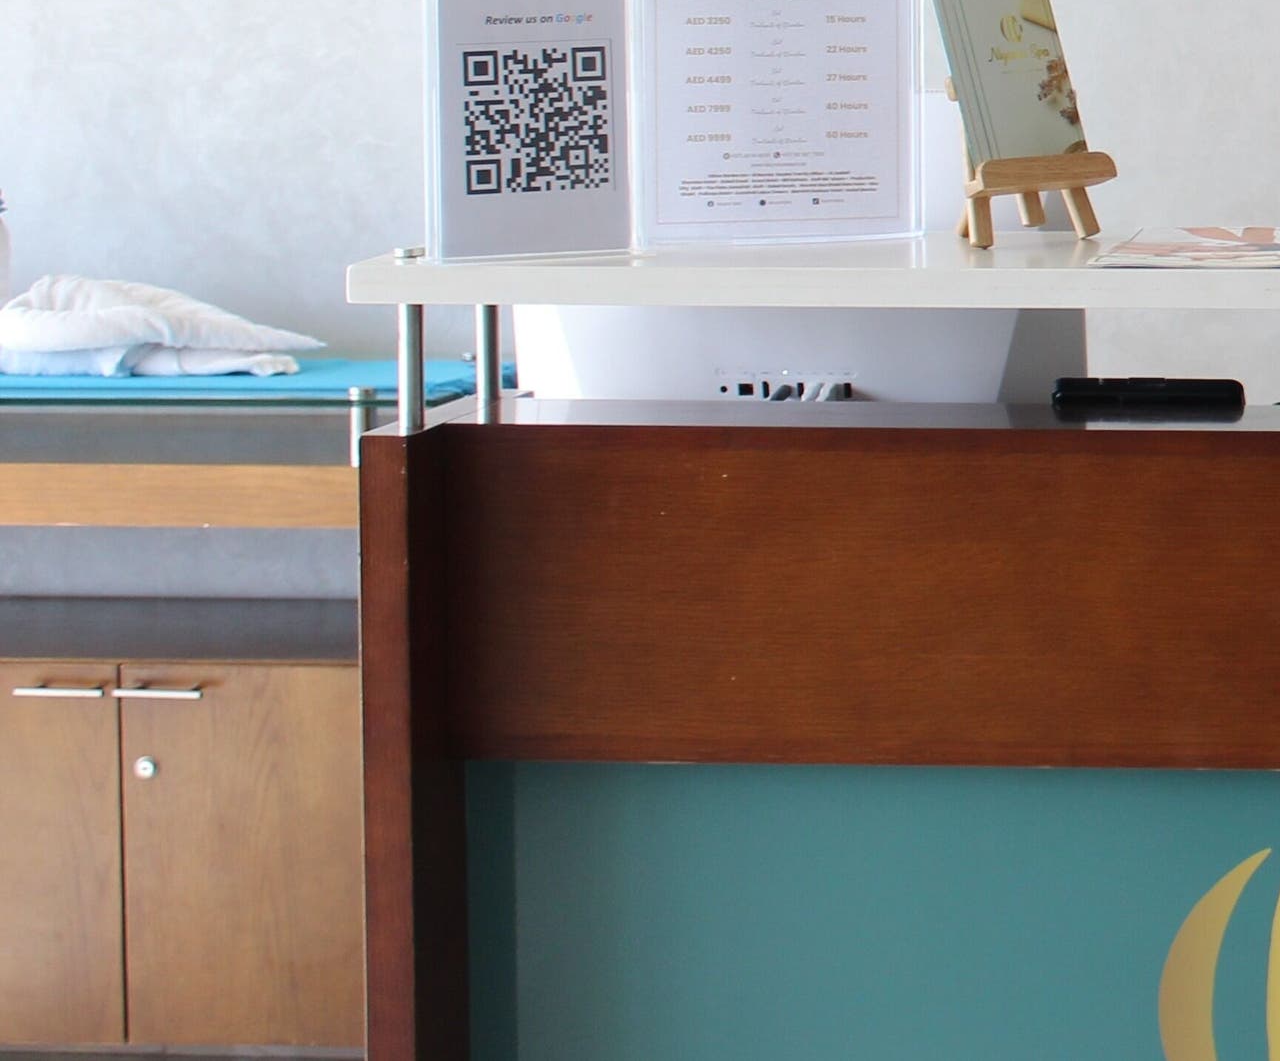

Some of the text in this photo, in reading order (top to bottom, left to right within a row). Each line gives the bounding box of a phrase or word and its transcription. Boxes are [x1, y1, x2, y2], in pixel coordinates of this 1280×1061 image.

[485, 15, 523, 26] Review
[526, 16, 537, 24] us
[540, 16, 554, 24] on
[686, 17, 705, 25] AED
[837, 15, 866, 23] Hours
[686, 47, 705, 55] AED
[838, 45, 868, 53] Hours
[686, 76, 705, 84] AED
[838, 74, 868, 82] Hours
[687, 105, 706, 113] AED
[840, 102, 869, 111] Hours
[687, 134, 706, 142] AED
[839, 131, 869, 139] Hours
